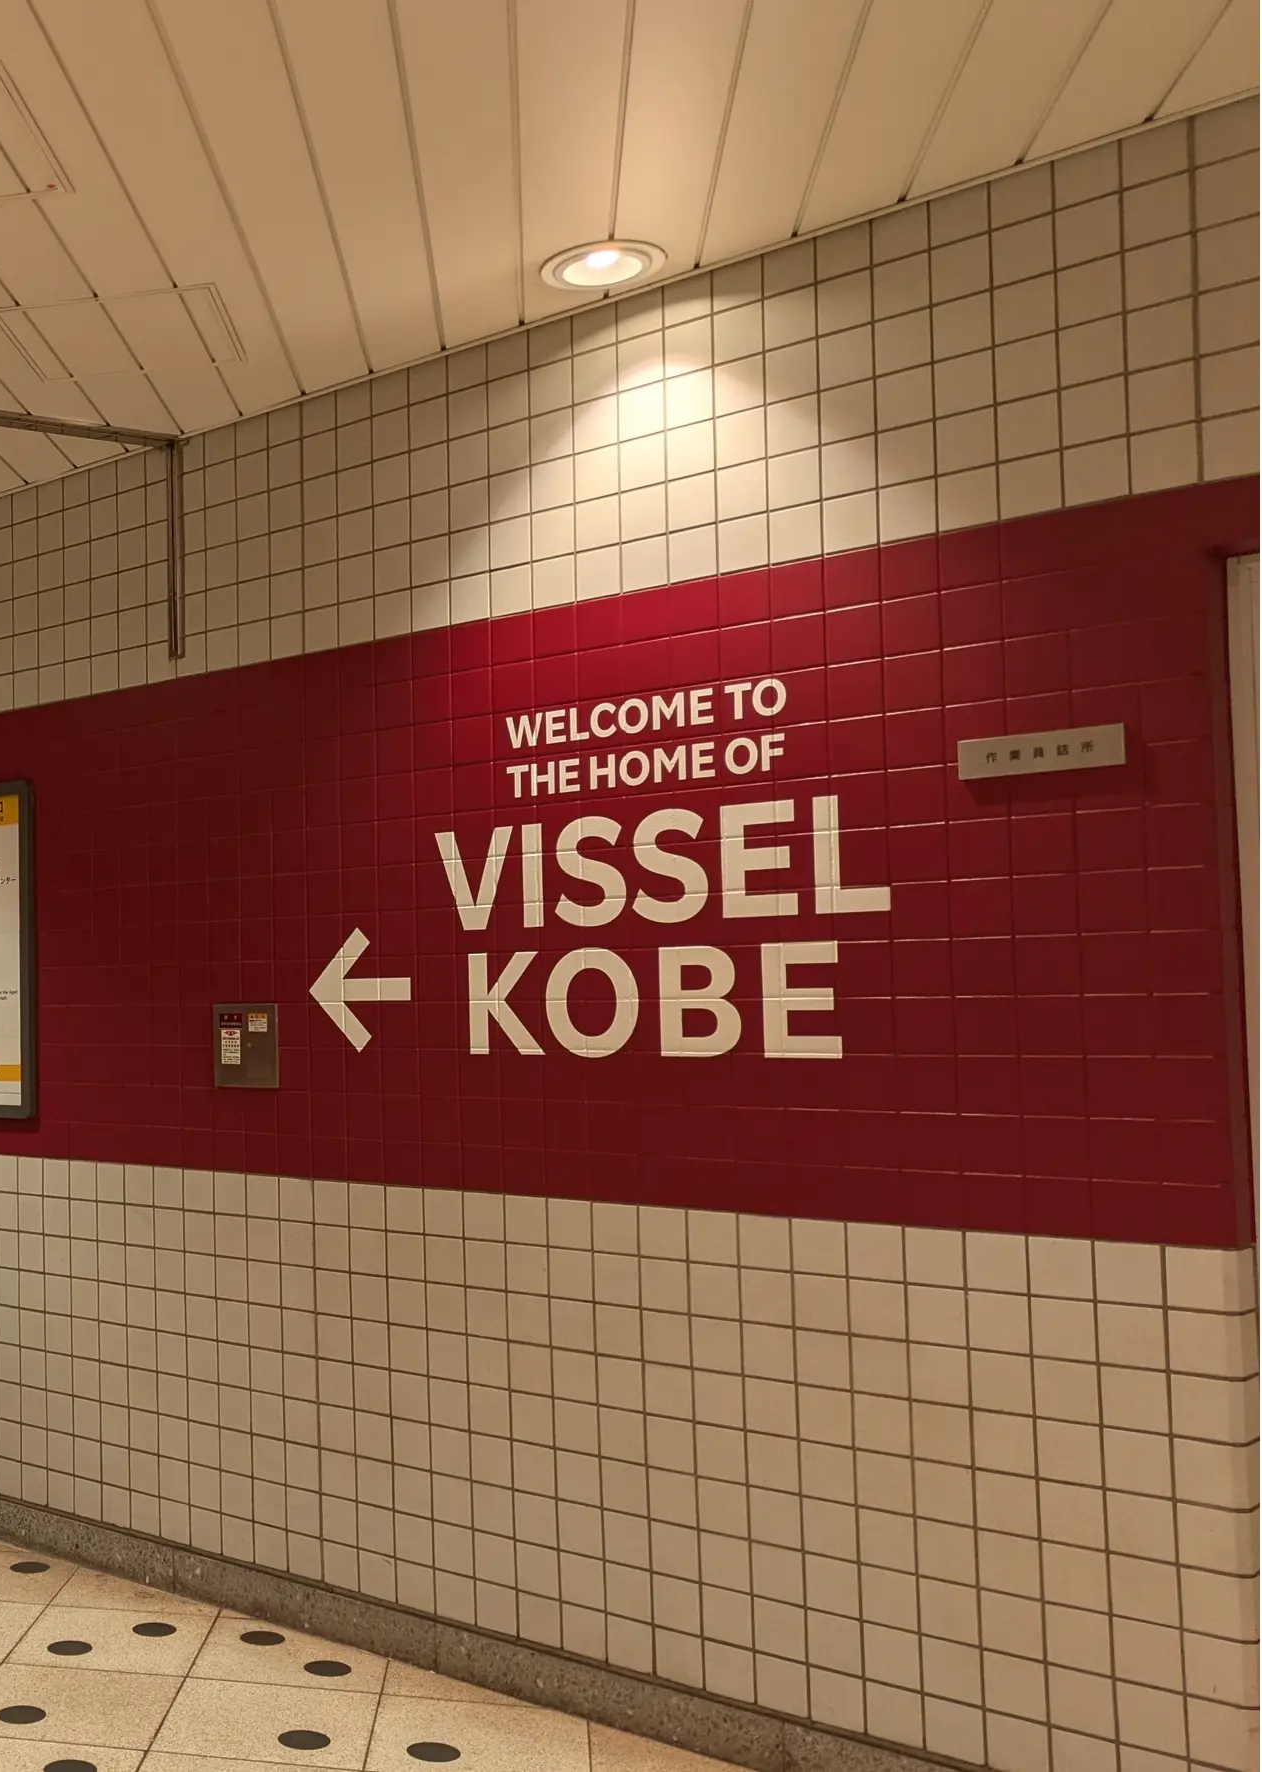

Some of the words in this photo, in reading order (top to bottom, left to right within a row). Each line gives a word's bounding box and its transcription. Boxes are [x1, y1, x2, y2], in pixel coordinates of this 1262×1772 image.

[506, 687, 714, 749] WELCOME
[724, 678, 787, 720] TO
[506, 758, 580, 798] THE
[590, 741, 716, 790] HOME
[724, 733, 785, 775] OF
[985, 740, 1094, 764] 作業員詰所
[434, 795, 891, 931] VISSEL
[467, 940, 843, 1059] KOBE
